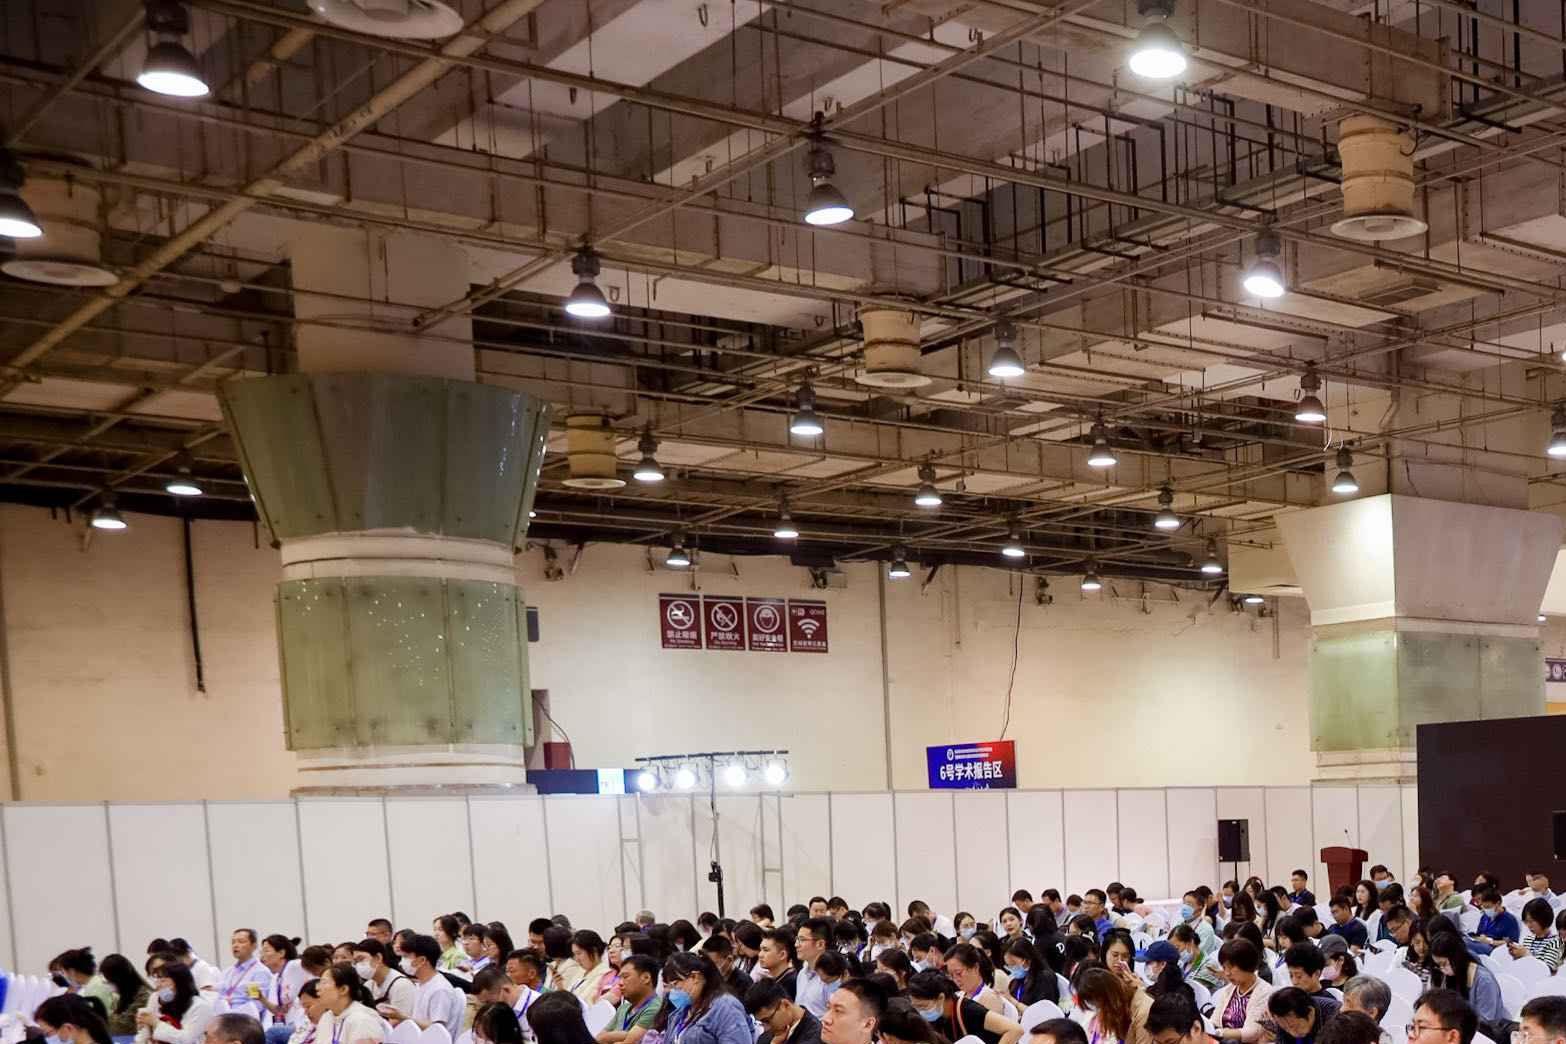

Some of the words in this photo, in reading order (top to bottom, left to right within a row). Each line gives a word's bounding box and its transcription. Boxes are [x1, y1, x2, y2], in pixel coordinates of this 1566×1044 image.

[940, 761, 1003, 780] 6号学术报告区
